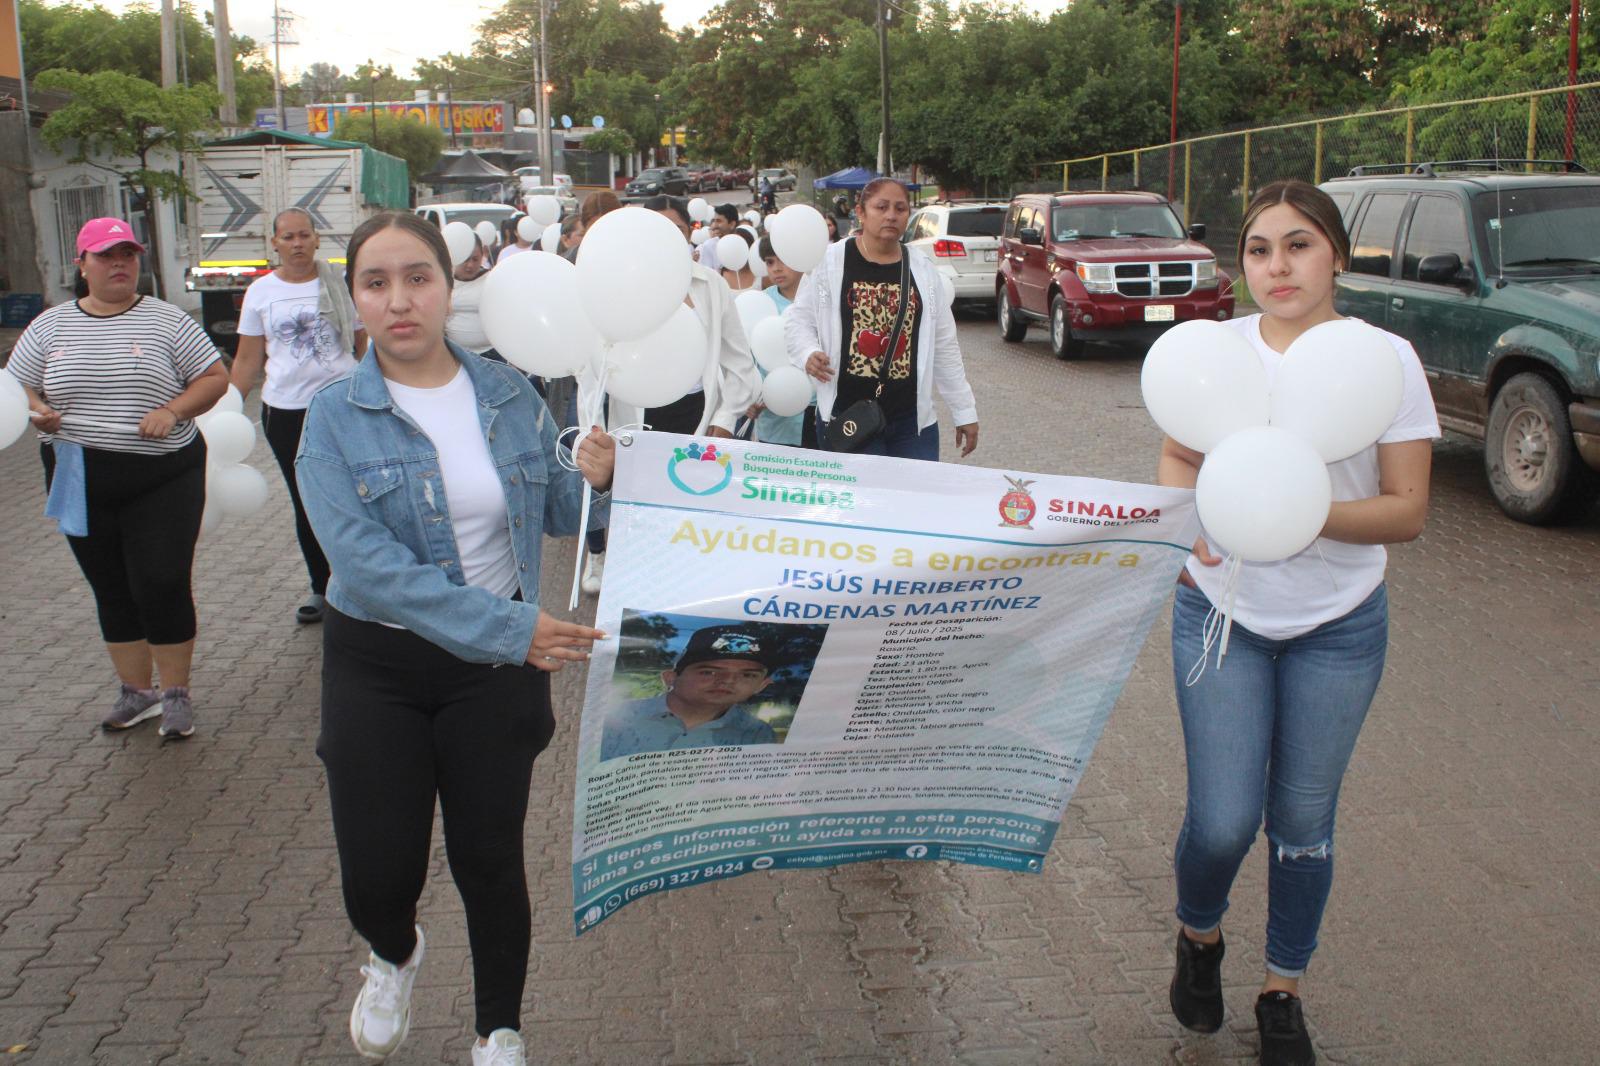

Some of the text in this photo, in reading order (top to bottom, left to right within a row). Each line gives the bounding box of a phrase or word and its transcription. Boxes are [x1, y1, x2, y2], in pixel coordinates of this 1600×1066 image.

[308, 106, 426, 132] KIKO
[744, 452, 843, 470] Comisión Estatal de
[743, 463, 857, 482] Búsqueda de Personas
[741, 476, 855, 510] Sinaloa
[1048, 499, 1160, 519] SINALOA
[1047, 515, 1101, 526] GOBIERNO
[671, 520, 1142, 572] Ayúdanos a encontrar a
[778, 568, 1023, 595] JESÚS HERIBERTO
[743, 594, 1041, 619] CÁRDENAS MARTÍNEZ
[882, 636, 933, 645] Municipio
[907, 627, 930, 635] Julio
[905, 651, 945, 659] Hombre
[628, 752, 665, 762] Cédula:
[588, 772, 613, 783] Ropa:
[582, 860, 597, 876] Si
[606, 839, 664, 865] tienes
[673, 820, 790, 845] información
[800, 814, 886, 830] referente
[895, 815, 907, 823] a
[915, 812, 955, 823] esta
[583, 865, 628, 894] llama
[633, 860, 645, 870] o
[769, 834, 791, 844] Tu
[796, 828, 855, 842] ayuda
[860, 827, 882, 836] es
[887, 825, 929, 837] muy
[934, 824, 1042, 846] importante.
[624, 861, 745, 901] (669) 327 8424
